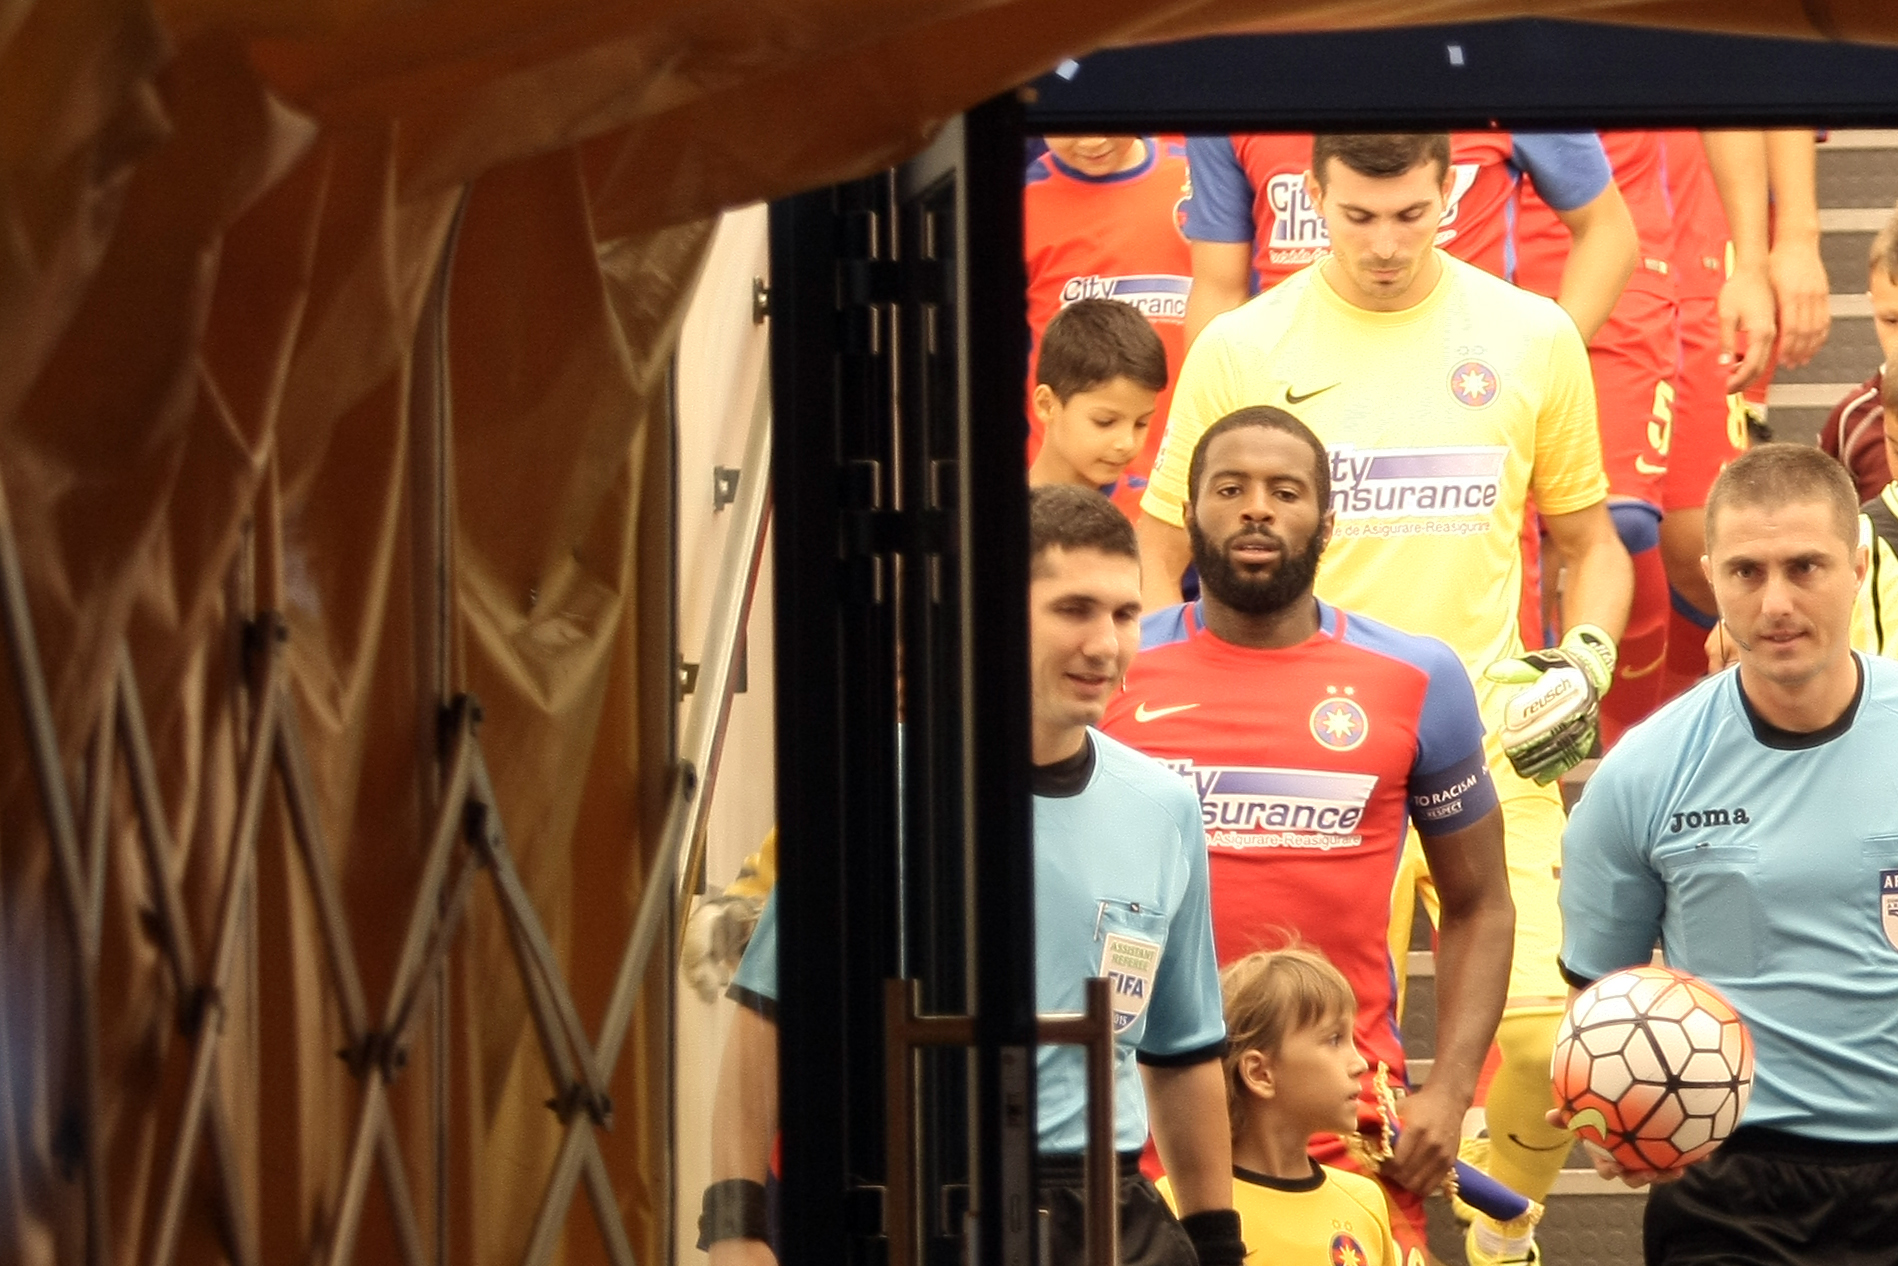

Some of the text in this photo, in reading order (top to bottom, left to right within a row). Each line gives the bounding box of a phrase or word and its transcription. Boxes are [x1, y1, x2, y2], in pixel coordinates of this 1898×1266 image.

[1271, 180, 1313, 212] Cit
[1646, 379, 1676, 457] 5
[1328, 450, 1370, 491] ty
[1330, 483, 1498, 514] nsurance
[1522, 678, 1572, 719] reusch
[1432, 774, 1478, 805] RACISM
[1202, 801, 1361, 830] surance
